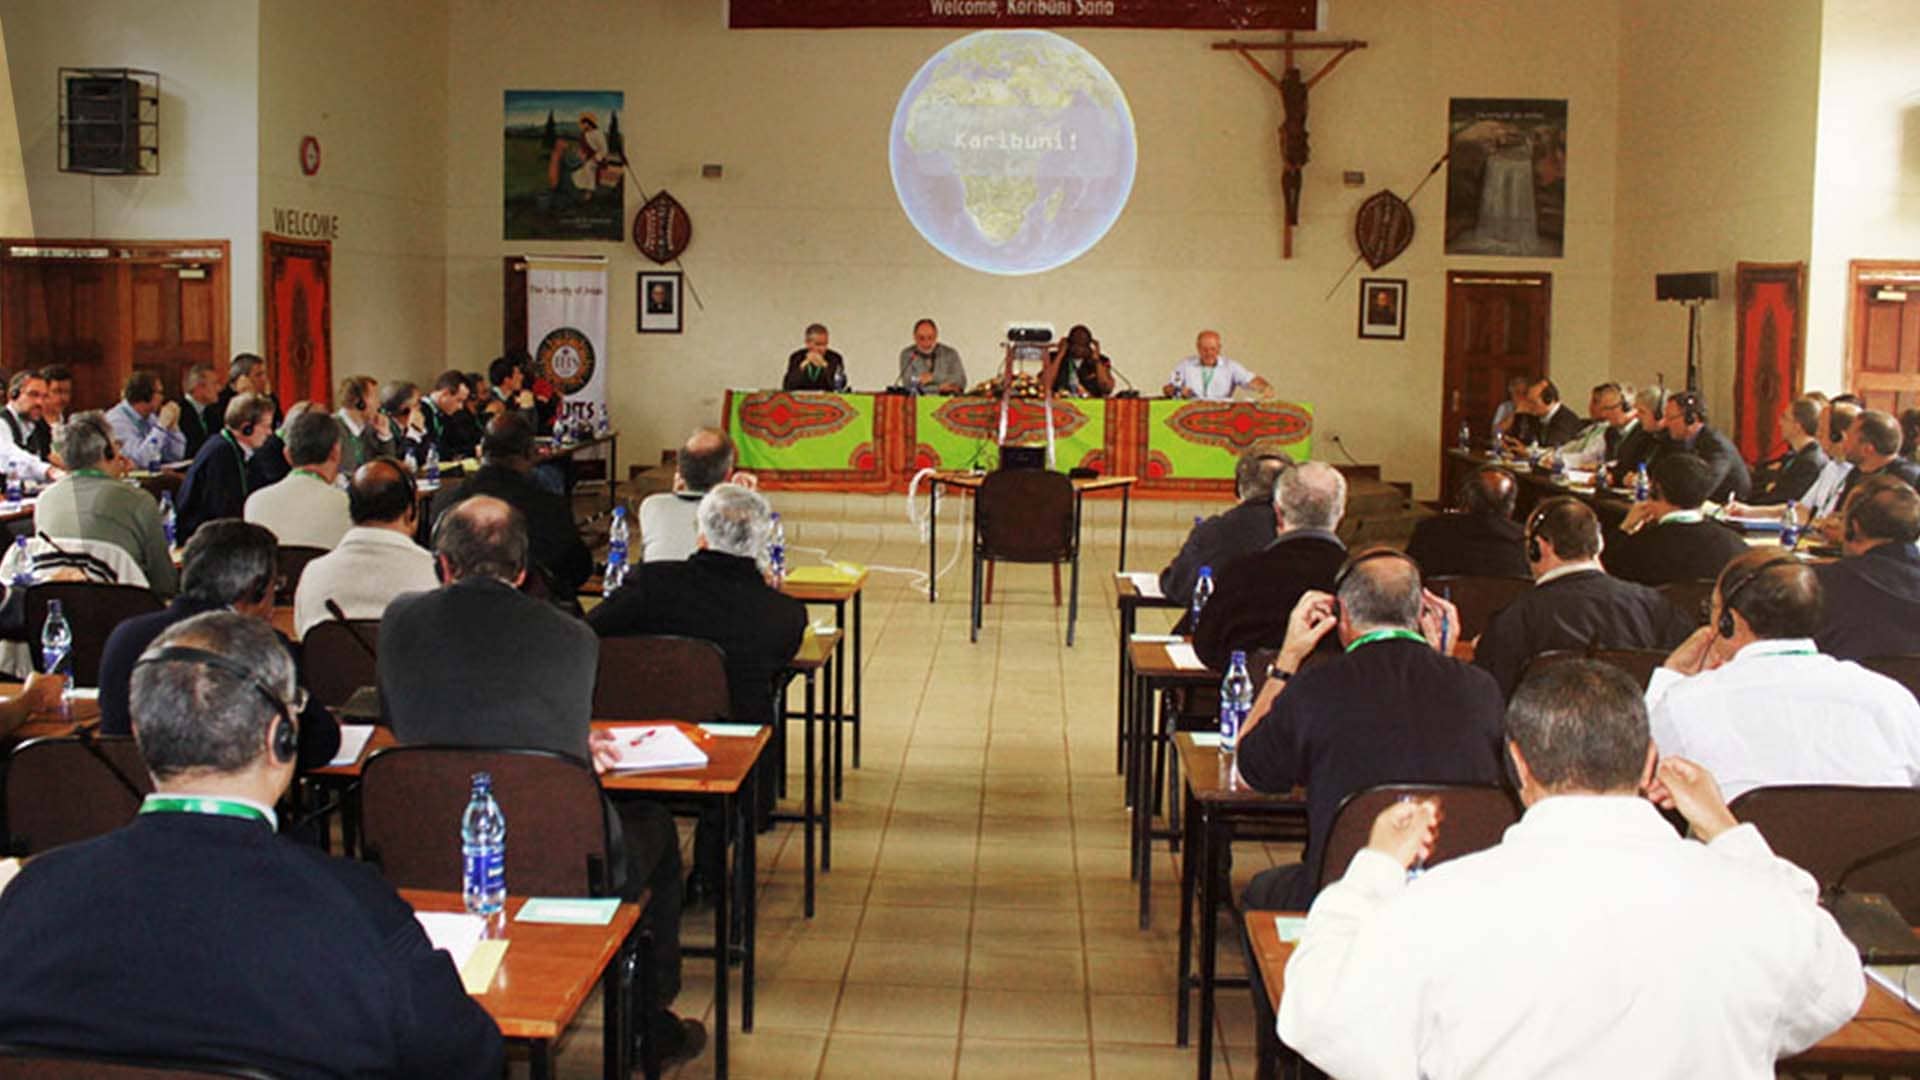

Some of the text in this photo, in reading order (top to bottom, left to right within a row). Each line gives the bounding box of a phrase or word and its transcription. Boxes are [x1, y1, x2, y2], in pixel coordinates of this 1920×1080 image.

[931, 0, 1000, 19] Welcome,
[1077, 0, 1115, 15] Sana
[953, 130, 1078, 151] Karibuni!
[273, 207, 340, 239] WELCOME
